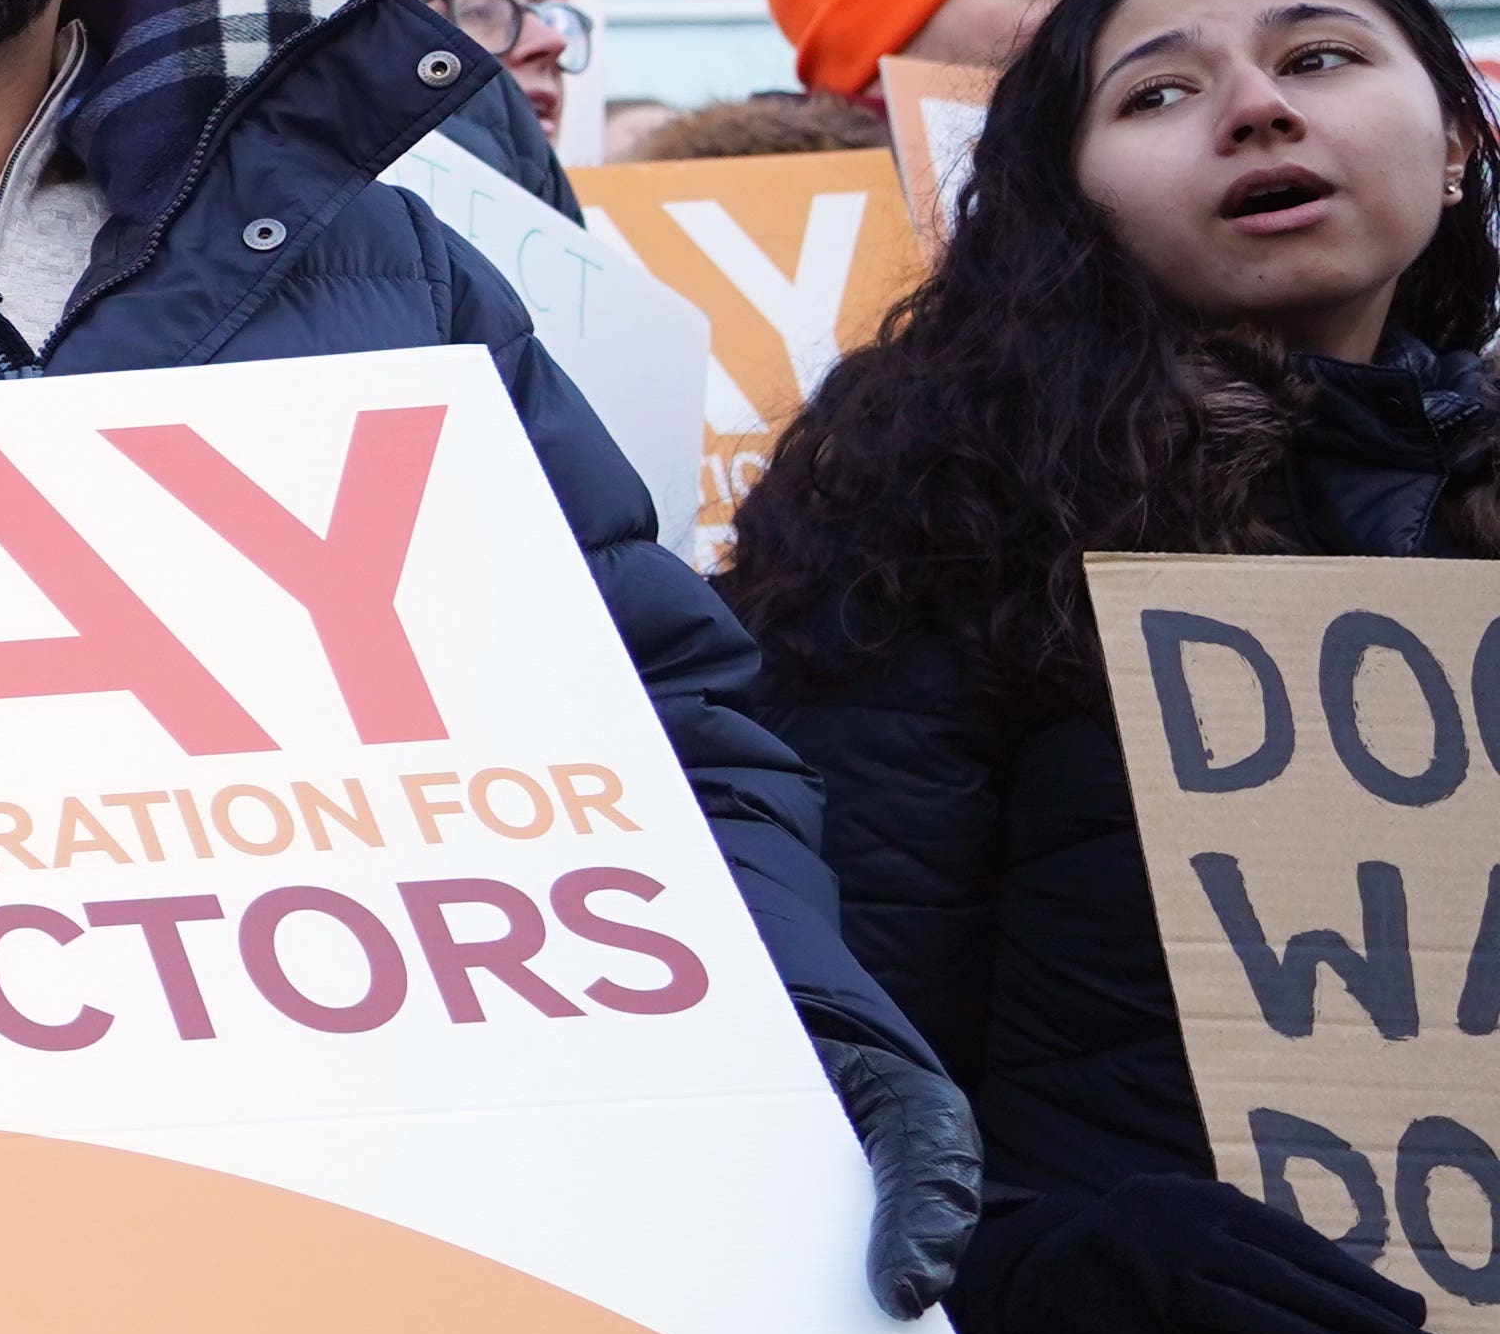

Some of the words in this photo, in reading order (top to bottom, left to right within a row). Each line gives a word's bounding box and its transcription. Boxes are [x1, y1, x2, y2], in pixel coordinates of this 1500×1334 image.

[1141, 609, 1500, 807] DO
[411, 762, 644, 847] FOR
[1189, 851, 1500, 1042] W
